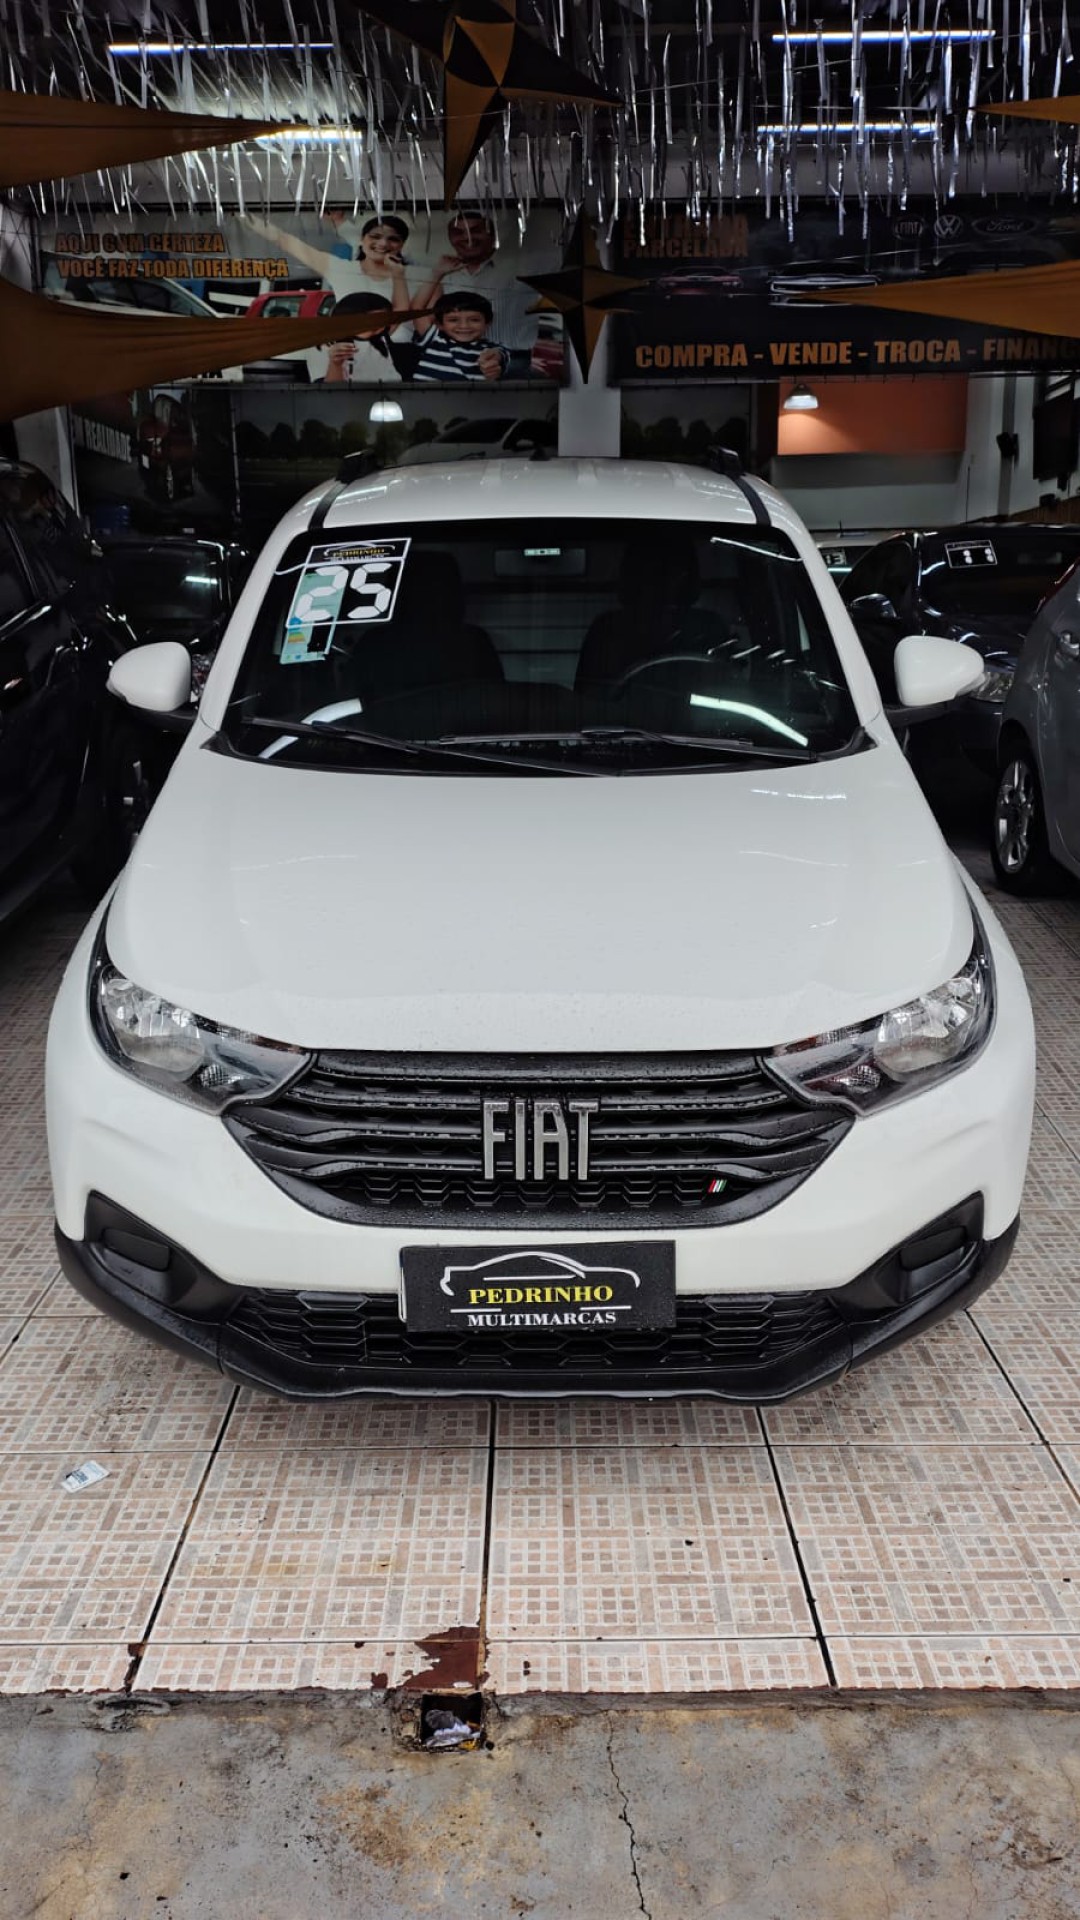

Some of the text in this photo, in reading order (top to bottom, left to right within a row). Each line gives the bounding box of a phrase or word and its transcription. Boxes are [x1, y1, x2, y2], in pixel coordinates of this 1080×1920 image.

[56, 233, 99, 253] AQUI
[149, 233, 225, 252] CERTEZA
[57, 256, 289, 280] VOCÊ FAZ TODA DIFERENÇA
[634, 342, 748, 369] COMPRA
[768, 340, 853, 366] VENDE
[873, 338, 961, 363] TROCA
[295, 562, 392, 622] 25
[483, 1102, 599, 1181] FIAT
[468, 1285, 614, 1305] PEDRINHO
[467, 1311, 617, 1328] MULTIMARCAS
